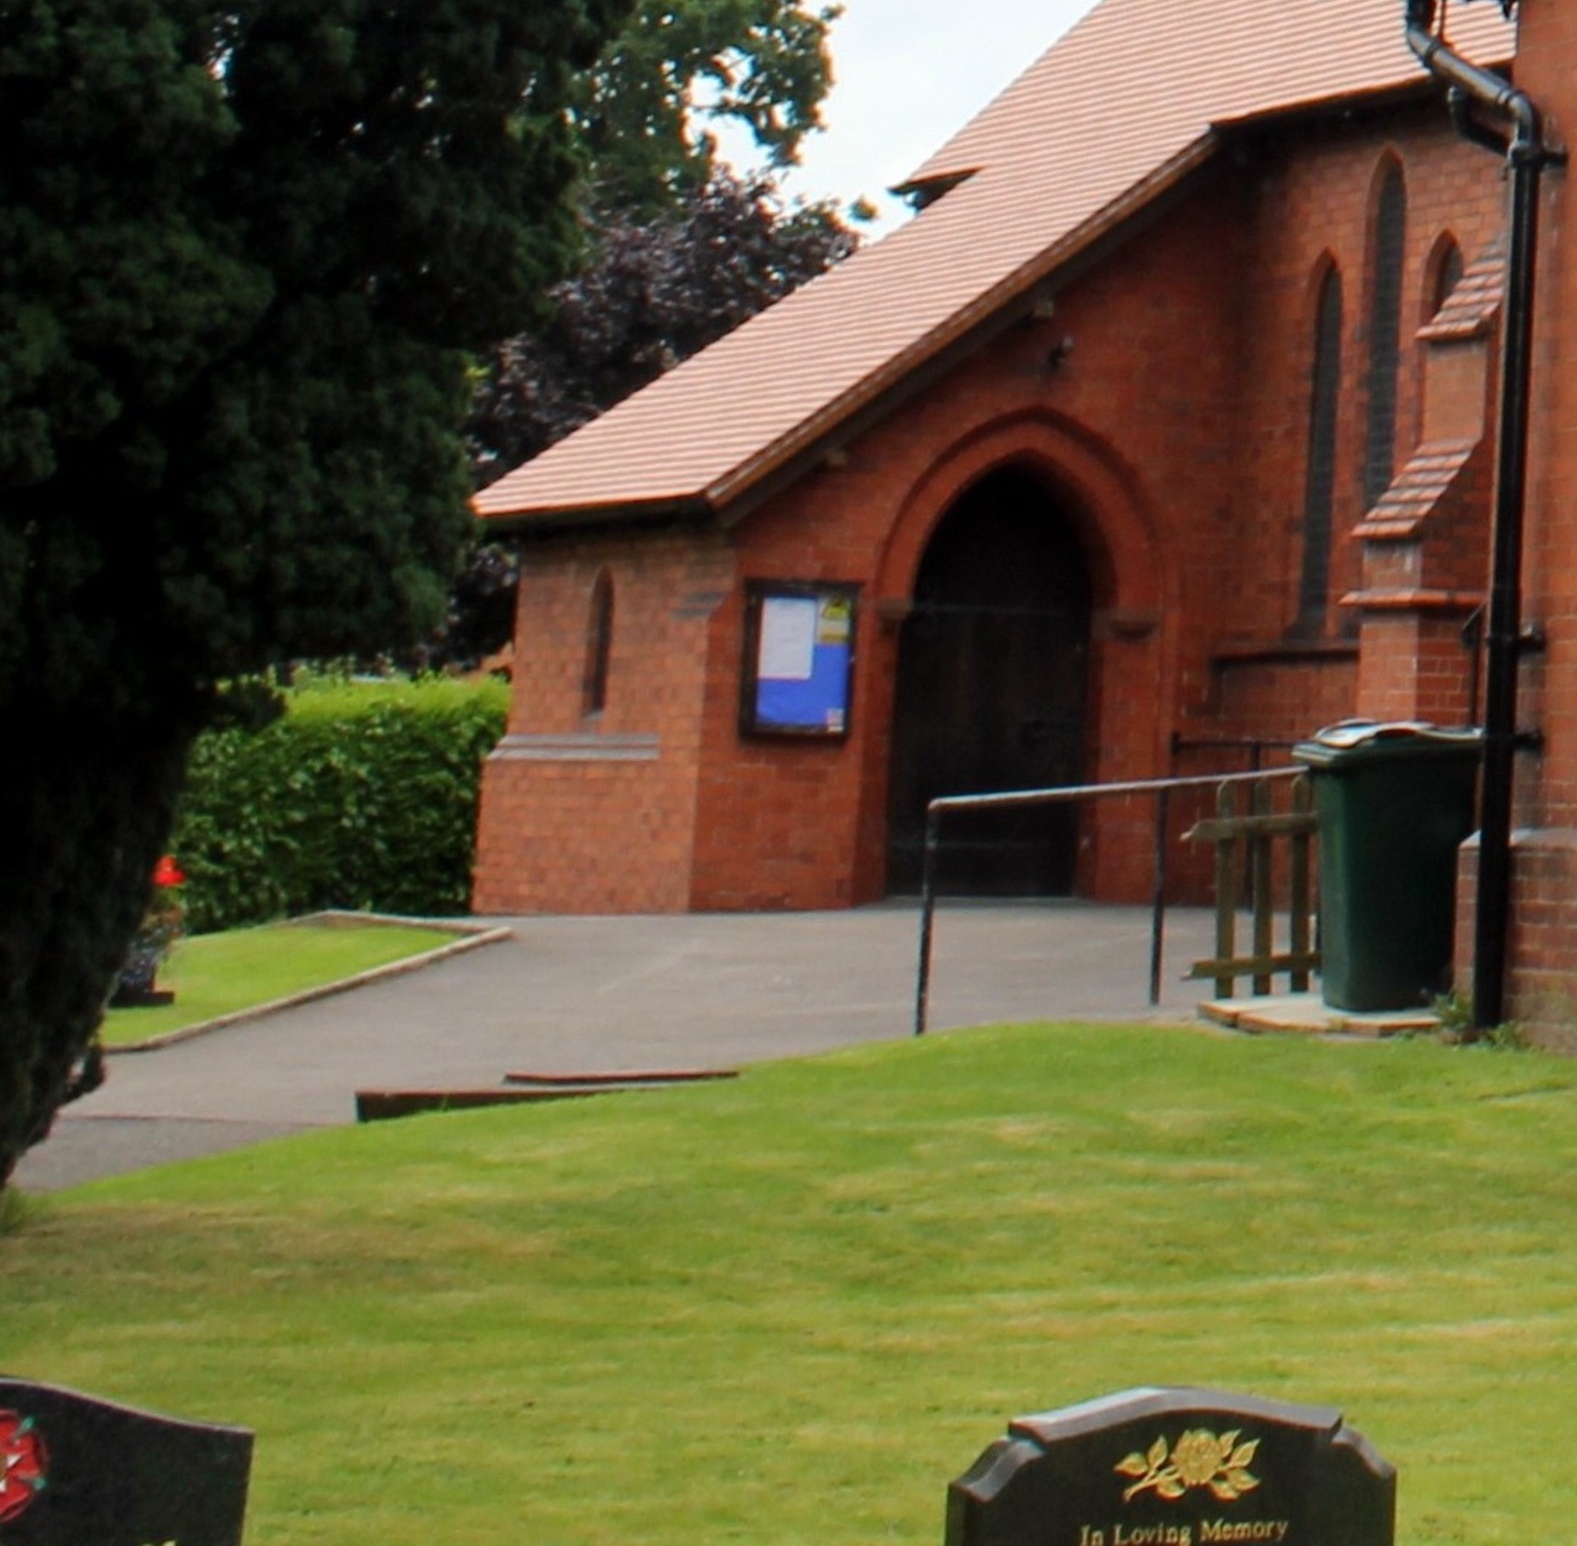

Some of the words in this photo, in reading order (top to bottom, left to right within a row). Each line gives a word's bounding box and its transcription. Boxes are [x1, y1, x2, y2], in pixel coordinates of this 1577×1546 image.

[1080, 1524, 1104, 1546] In
[1113, 1522, 1192, 1546] Loving
[1200, 1518, 1289, 1544] Memory
